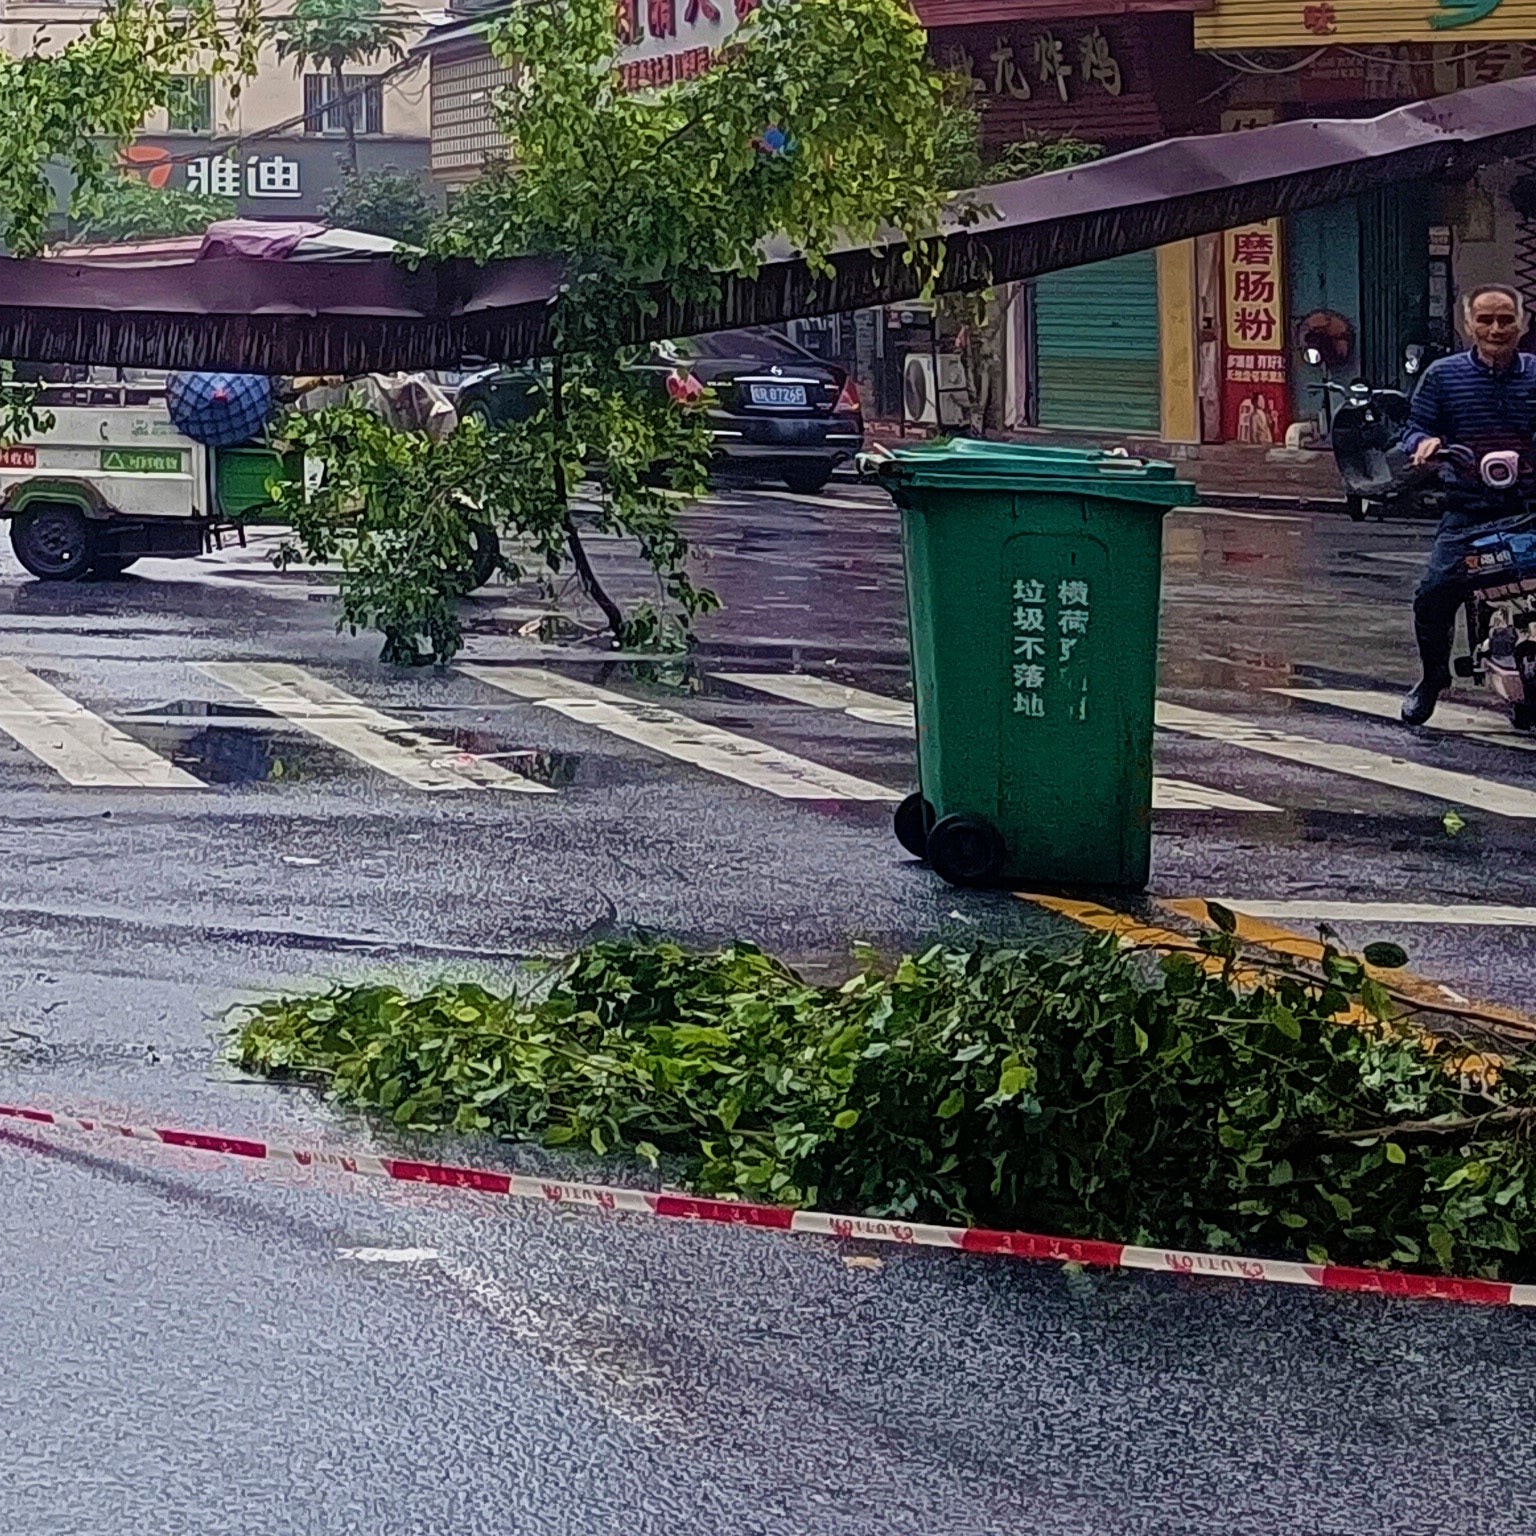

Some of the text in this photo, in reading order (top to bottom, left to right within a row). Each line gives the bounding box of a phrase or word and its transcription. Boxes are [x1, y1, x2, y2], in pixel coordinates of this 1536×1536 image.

[186, 155, 302, 198] 雅迪
[1232, 221, 1277, 342] 磨肠粉
[1013, 579, 1046, 717] 垃圾不落地
[828, 1217, 914, 1244] CAUTION
[1164, 1252, 1265, 1280] CAUTION
